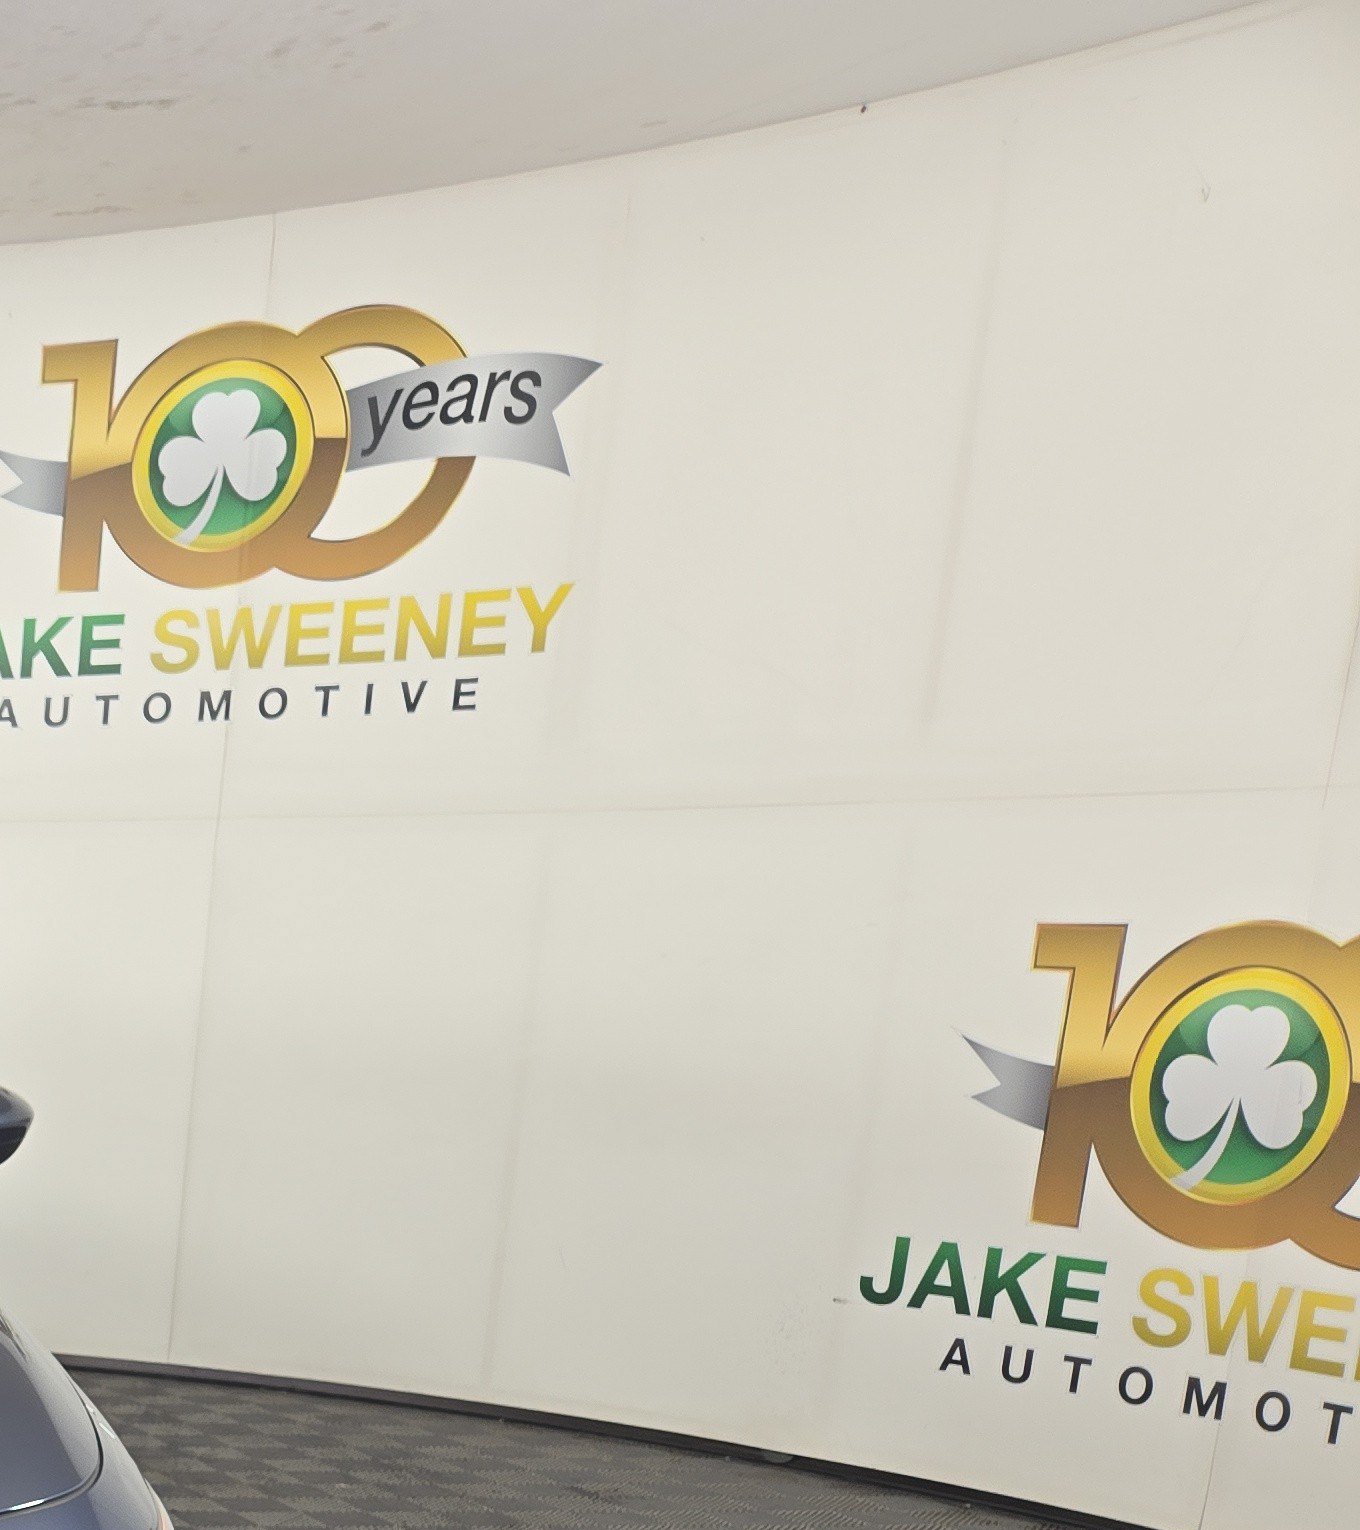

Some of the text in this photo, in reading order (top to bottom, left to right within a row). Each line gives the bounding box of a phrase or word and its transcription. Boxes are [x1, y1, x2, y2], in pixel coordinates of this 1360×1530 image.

[360, 365, 543, 457] years
[149, 582, 575, 675] SWEENEY
[859, 1236, 1360, 1382] JAKE SWE
